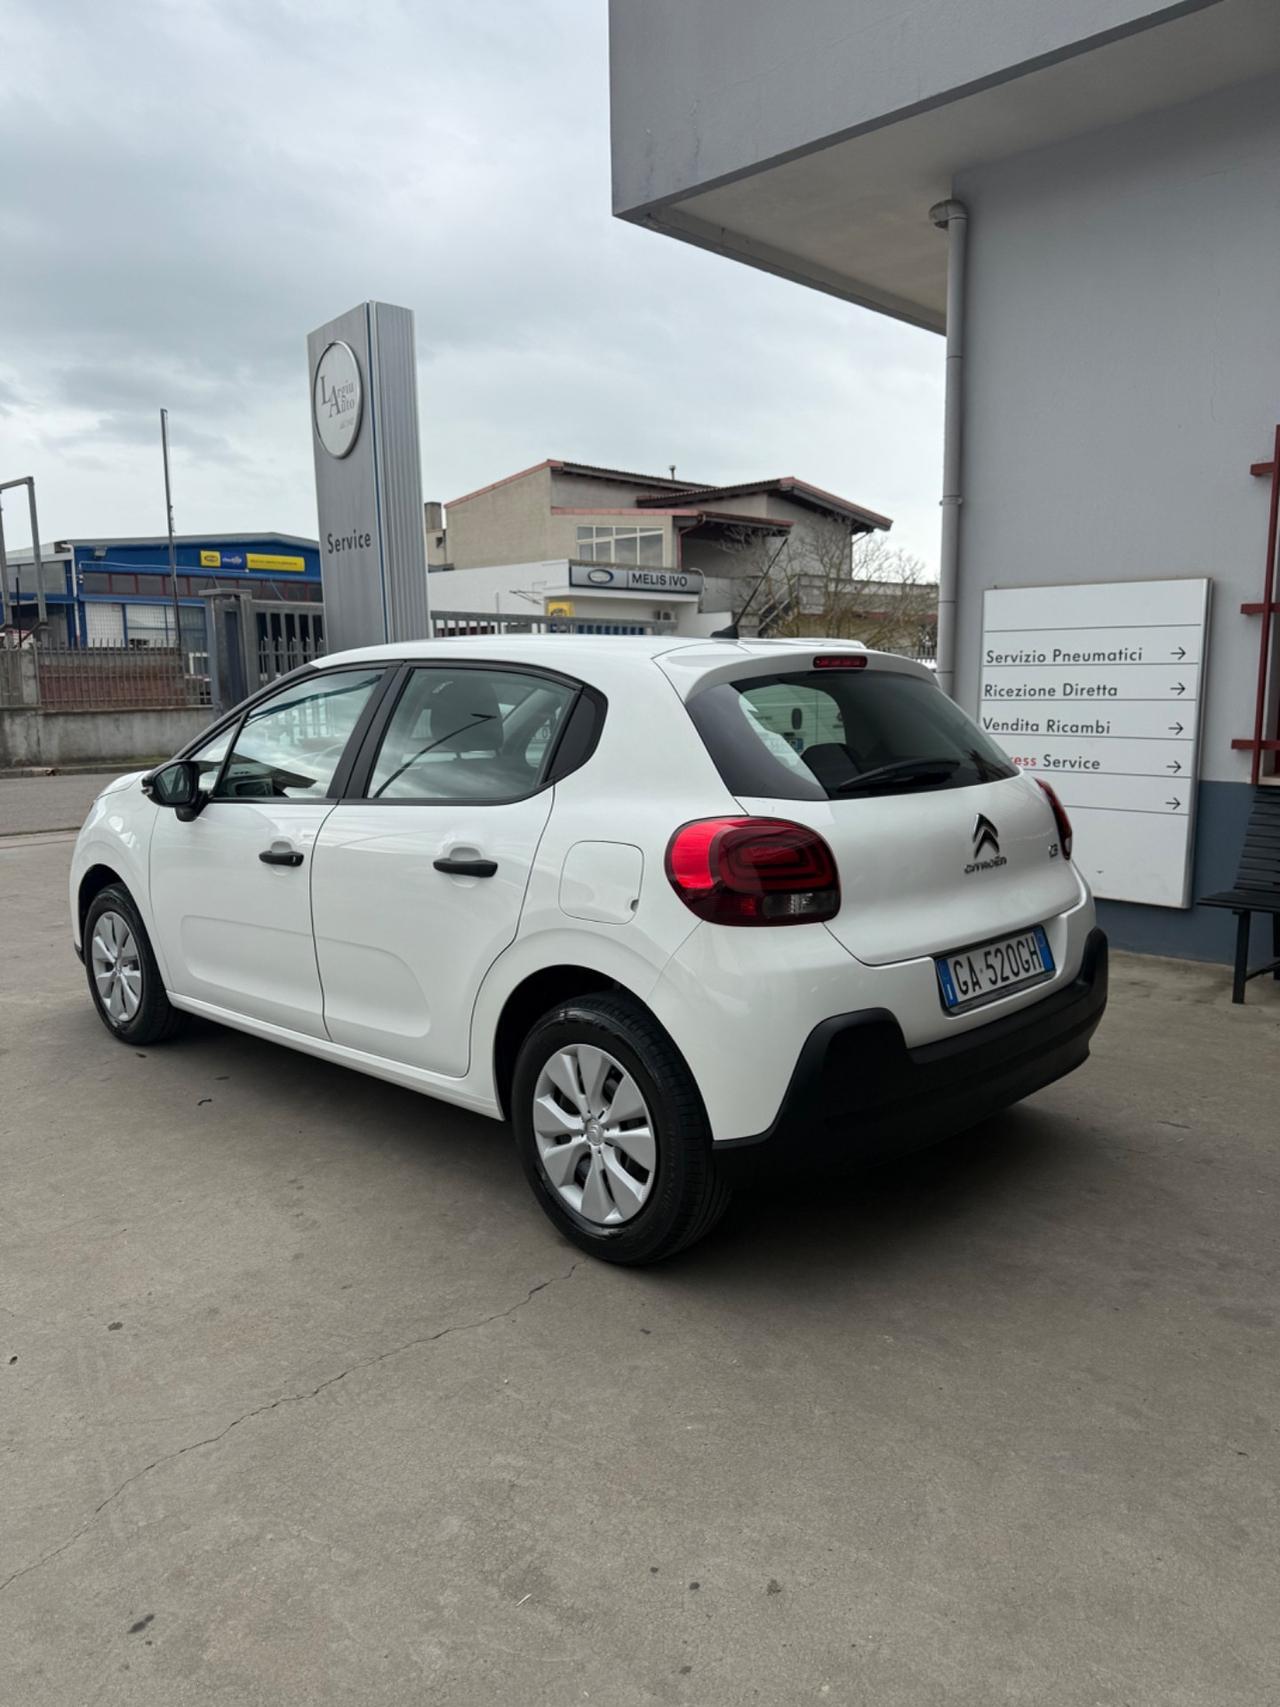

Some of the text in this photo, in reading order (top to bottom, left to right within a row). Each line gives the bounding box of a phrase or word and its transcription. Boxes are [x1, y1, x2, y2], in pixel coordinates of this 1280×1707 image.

[327, 528, 371, 554] Service
[632, 573, 688, 588] MELIS IVO
[986, 647, 1143, 664] Servizio Pneumatici
[984, 682, 1118, 698] Ricezione Diretta
[983, 716, 1111, 735] Vendita Ricambi
[1043, 753, 1101, 770] Service
[953, 936, 1043, 995] GA 520GH
